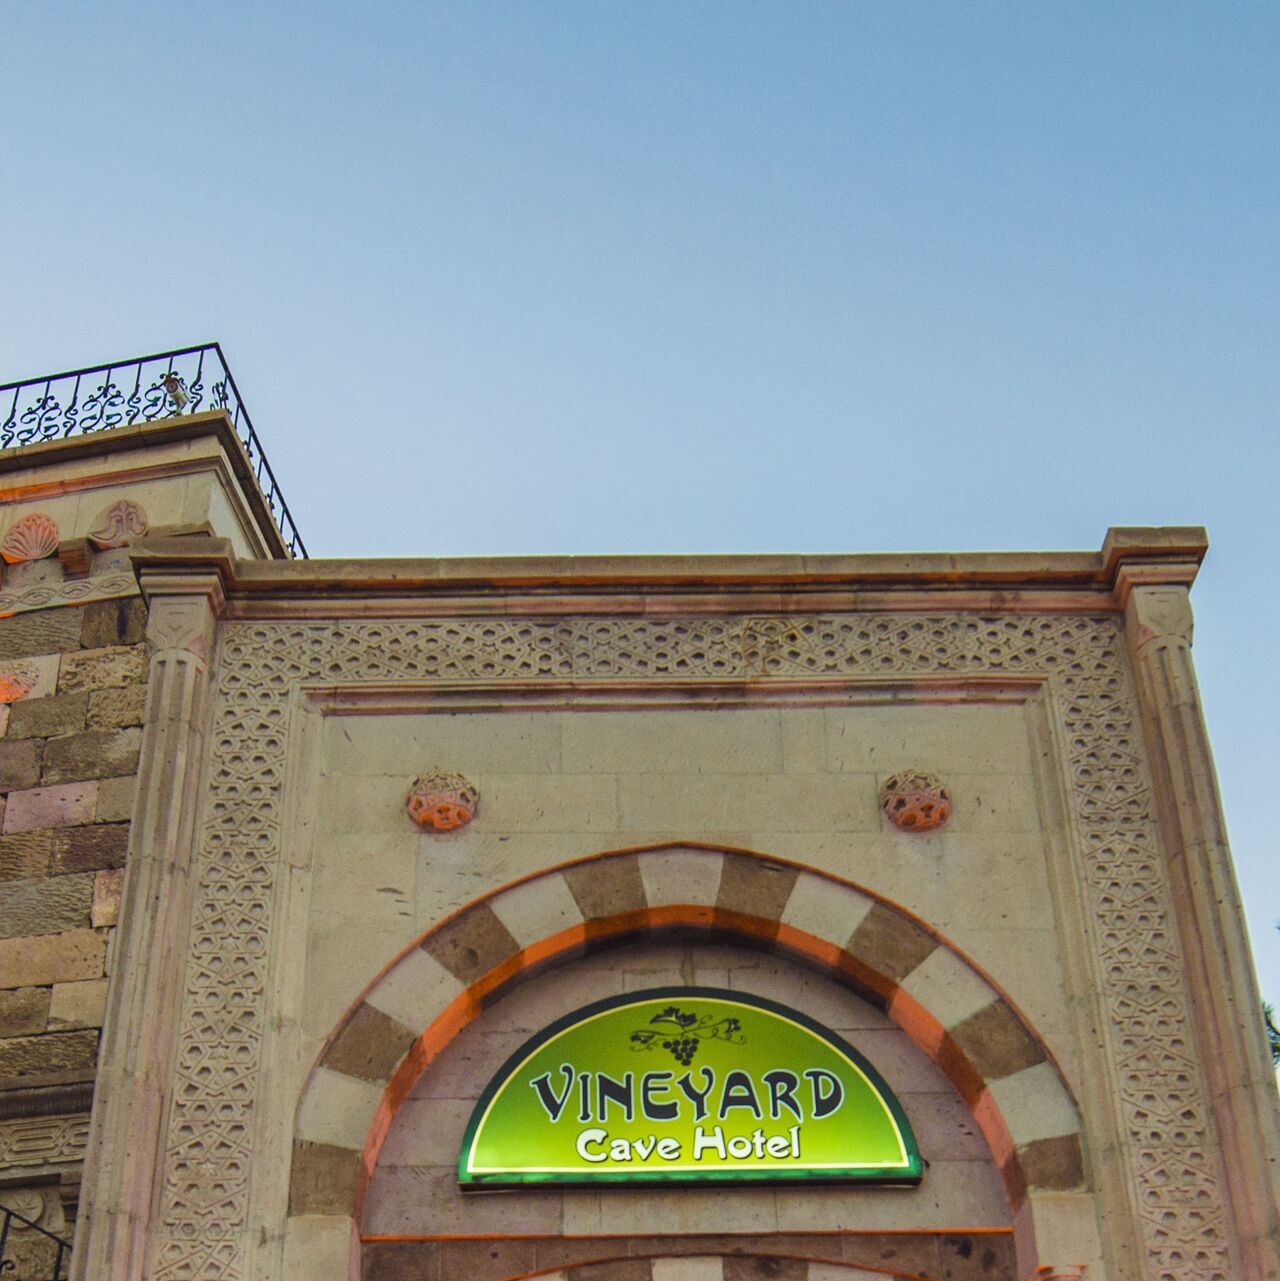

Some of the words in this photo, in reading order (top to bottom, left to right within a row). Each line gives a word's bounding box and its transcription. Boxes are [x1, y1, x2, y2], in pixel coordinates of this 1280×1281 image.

[530, 1063, 845, 1123] VINEYARD
[576, 1128, 680, 1162] Cave
[693, 1125, 801, 1160] Hotel
